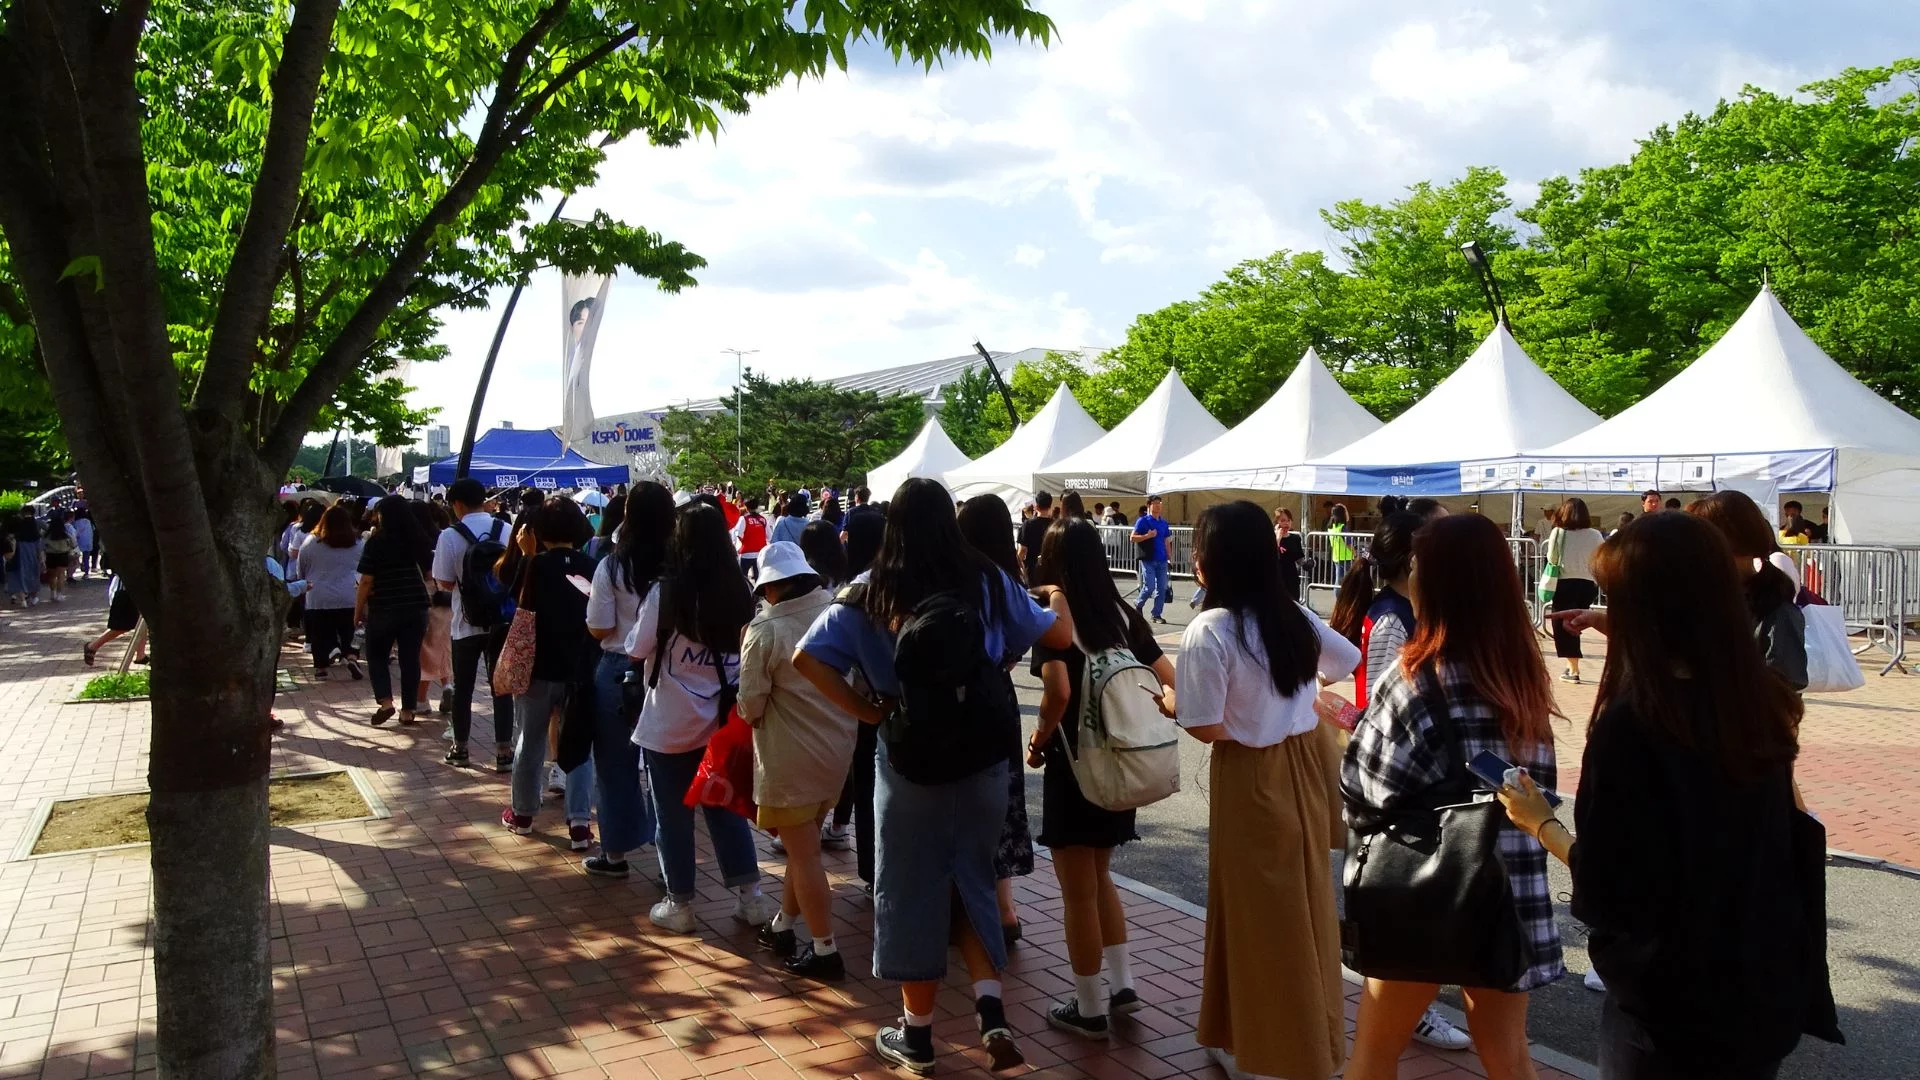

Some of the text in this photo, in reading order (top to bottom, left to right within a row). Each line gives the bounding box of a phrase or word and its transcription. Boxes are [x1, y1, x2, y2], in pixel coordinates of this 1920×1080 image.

[592, 427, 654, 445] KSPO DOME
[1064, 479, 1108, 489] EXPRESS BOOTH
